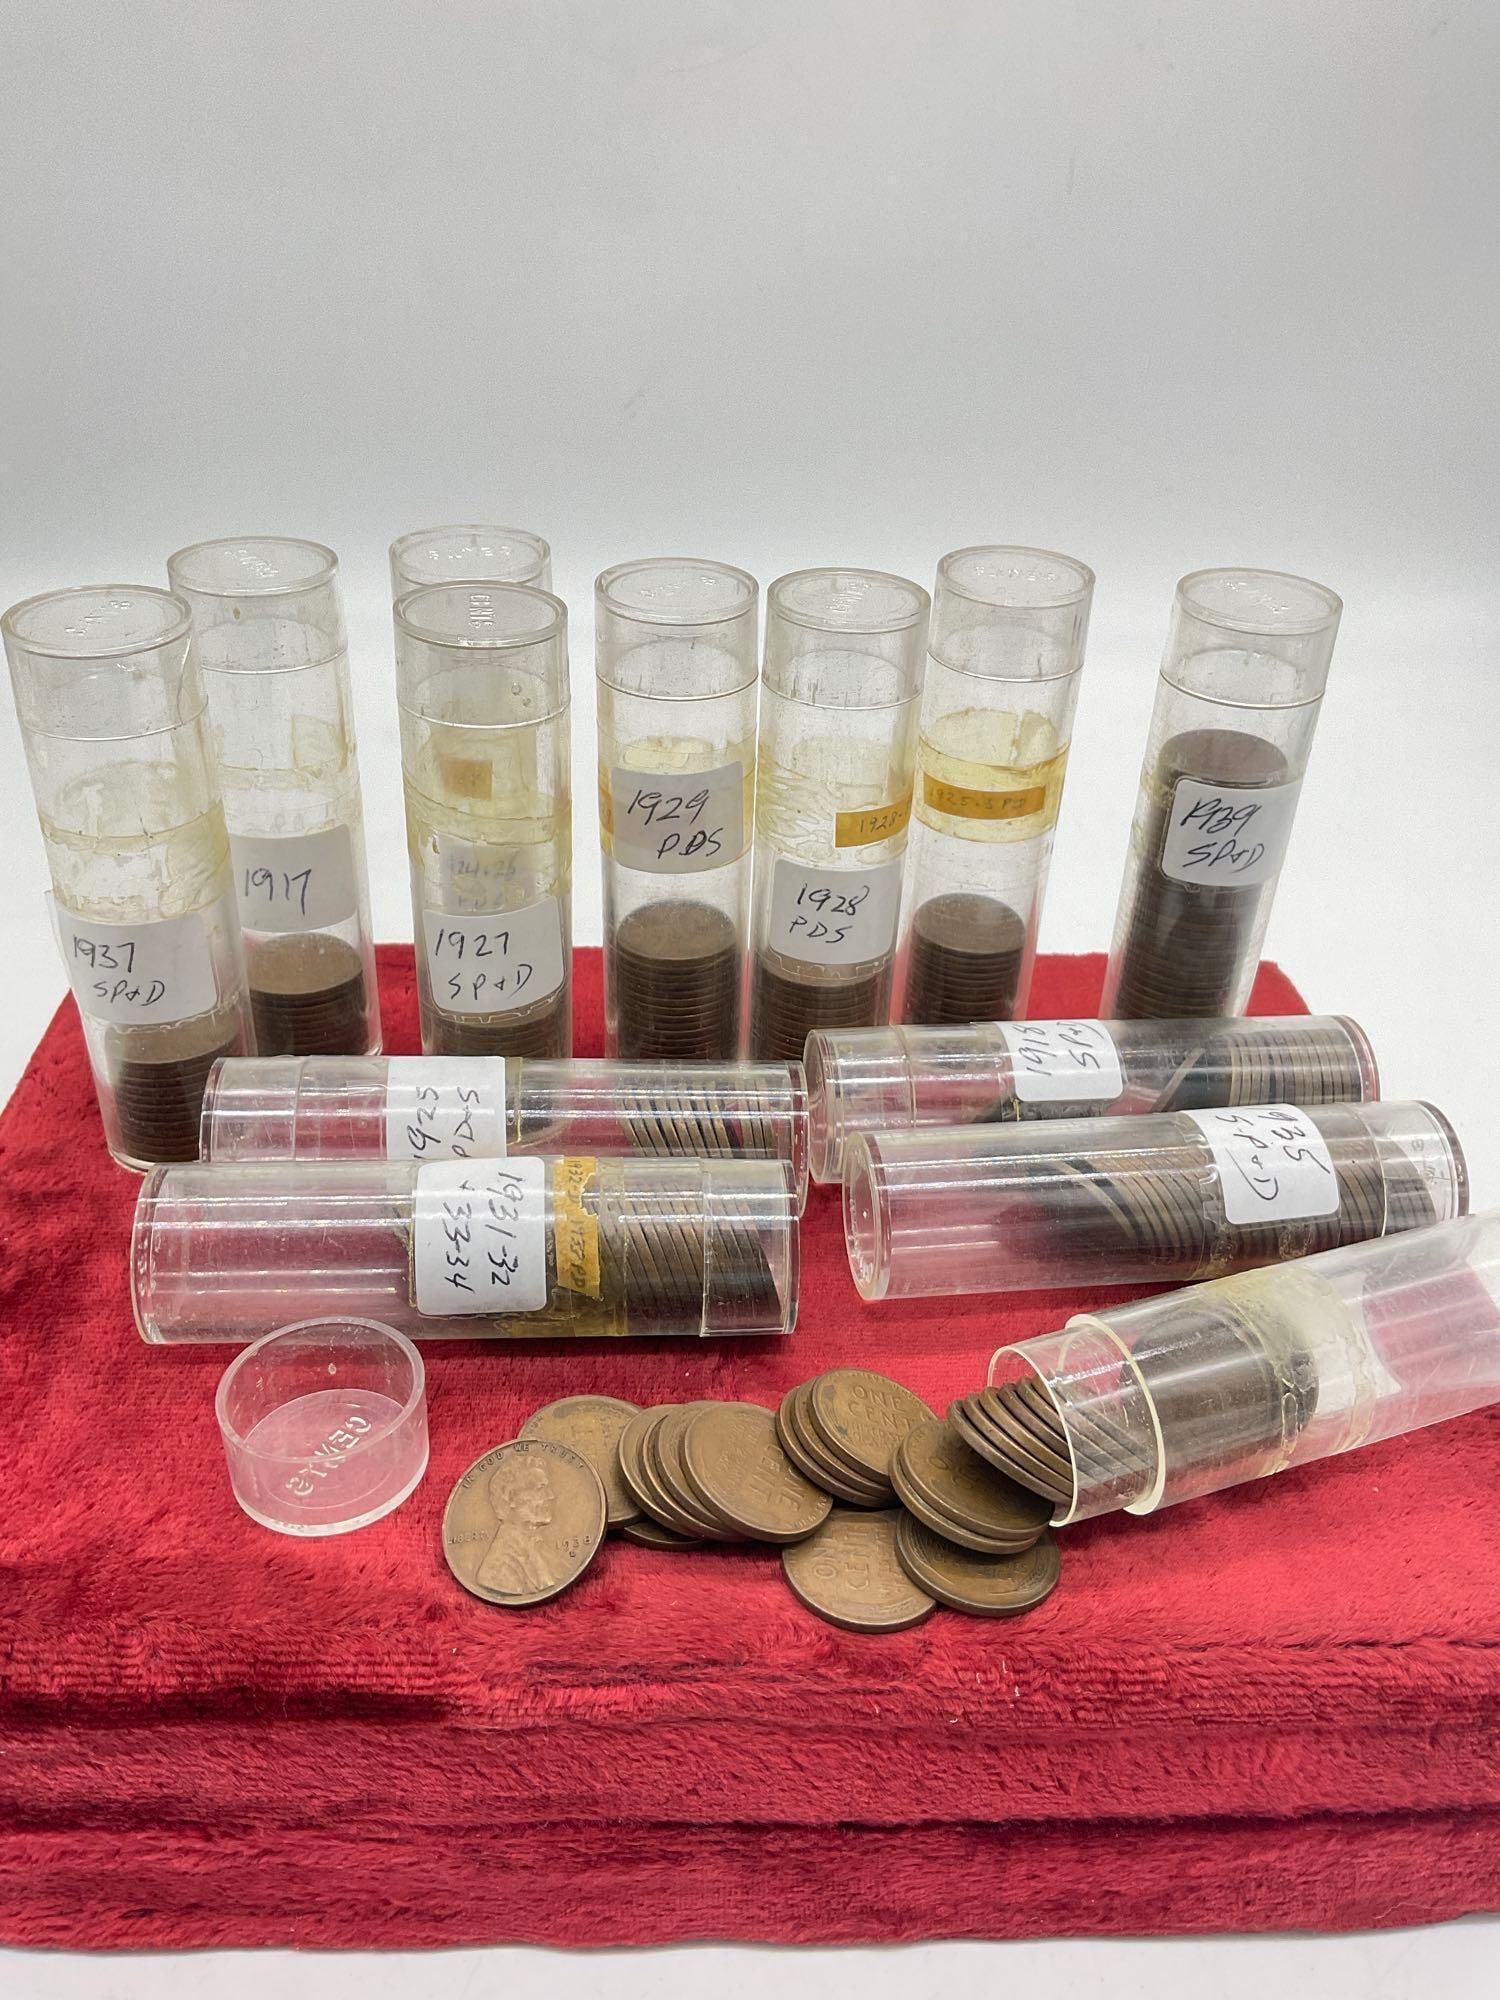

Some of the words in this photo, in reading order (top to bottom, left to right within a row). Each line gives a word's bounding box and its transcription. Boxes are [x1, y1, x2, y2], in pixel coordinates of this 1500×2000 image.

[627, 788, 710, 826] 1929
[1180, 798, 1263, 837] 1939
[244, 867, 312, 916] 1917
[796, 883, 871, 917] 1928
[434, 928, 510, 960] 1927
[789, 914, 853, 944] PDS
[72, 935, 136, 974] 1937
[1011, 1023, 1058, 1077] 1918
[406, 1086, 442, 1160] 1925
[479, 1450, 505, 1472] GOD
[514, 1443, 530, 1453] WE
